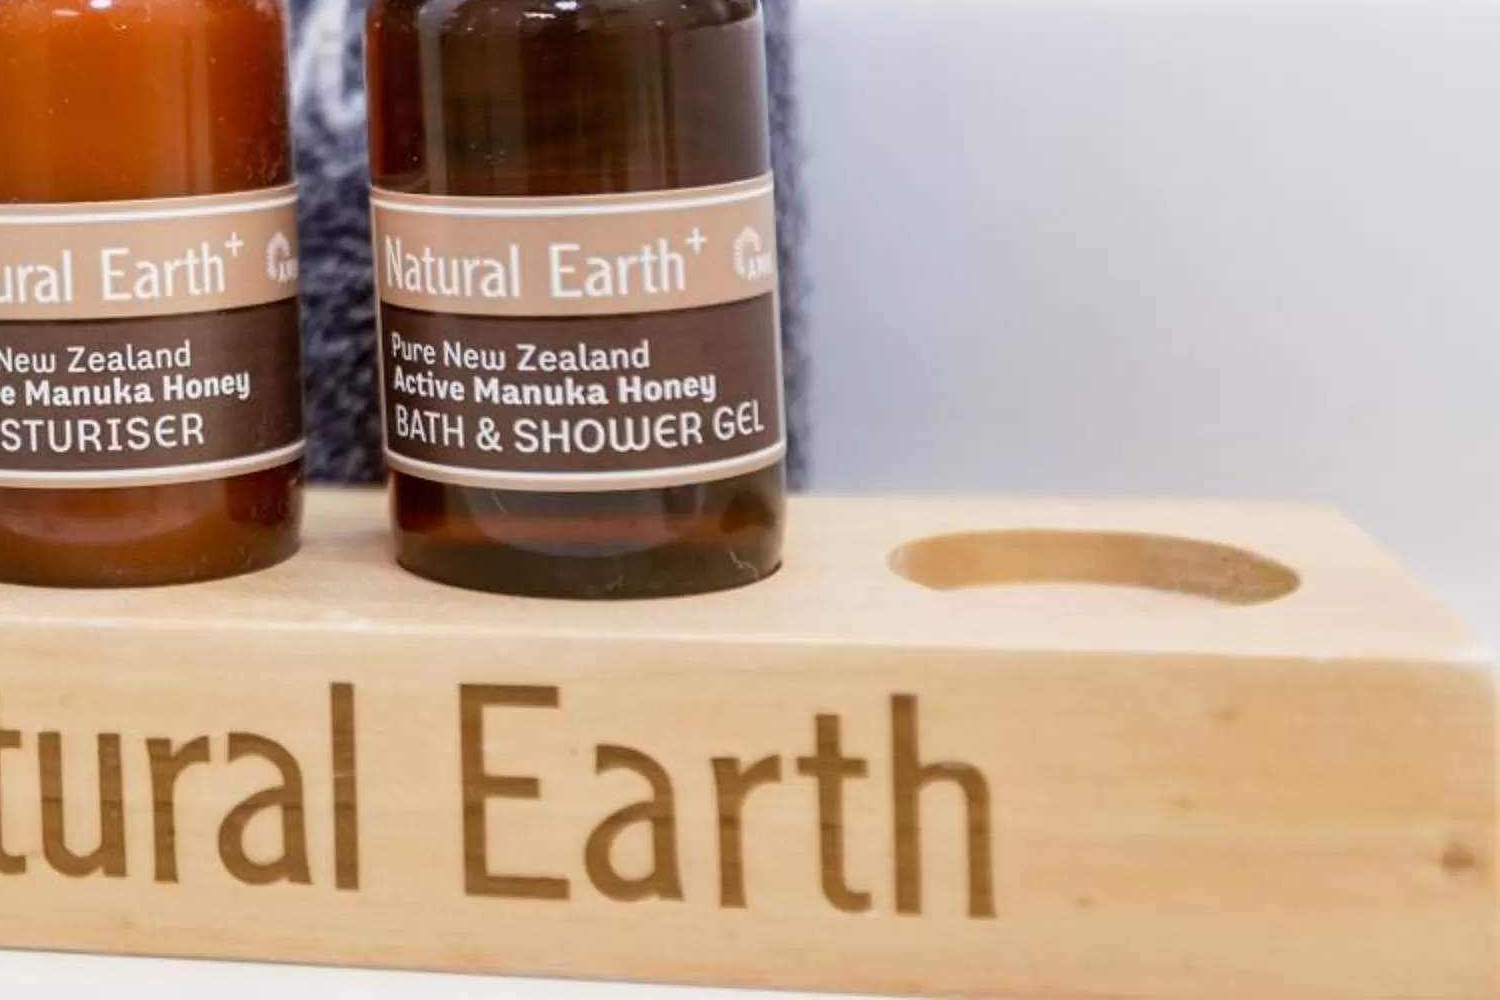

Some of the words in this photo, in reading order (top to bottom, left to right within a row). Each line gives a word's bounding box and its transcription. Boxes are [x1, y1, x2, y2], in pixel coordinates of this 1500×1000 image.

[384, 233, 520, 298] Natural
[67, 339, 192, 373] Zealand
[391, 331, 435, 364] Pure
[443, 340, 506, 371] New
[516, 338, 650, 372] Zealand
[25, 379, 154, 407] Manuka
[163, 371, 250, 400] Honey
[393, 367, 465, 401] Active
[473, 375, 609, 406] Manuka
[618, 373, 717, 406] Honey
[395, 405, 465, 449] BATH
[476, 418, 503, 453] &
[513, 410, 703, 455] SHOWER
[712, 399, 765, 442] GEL
[459, 682, 999, 921] Earth
